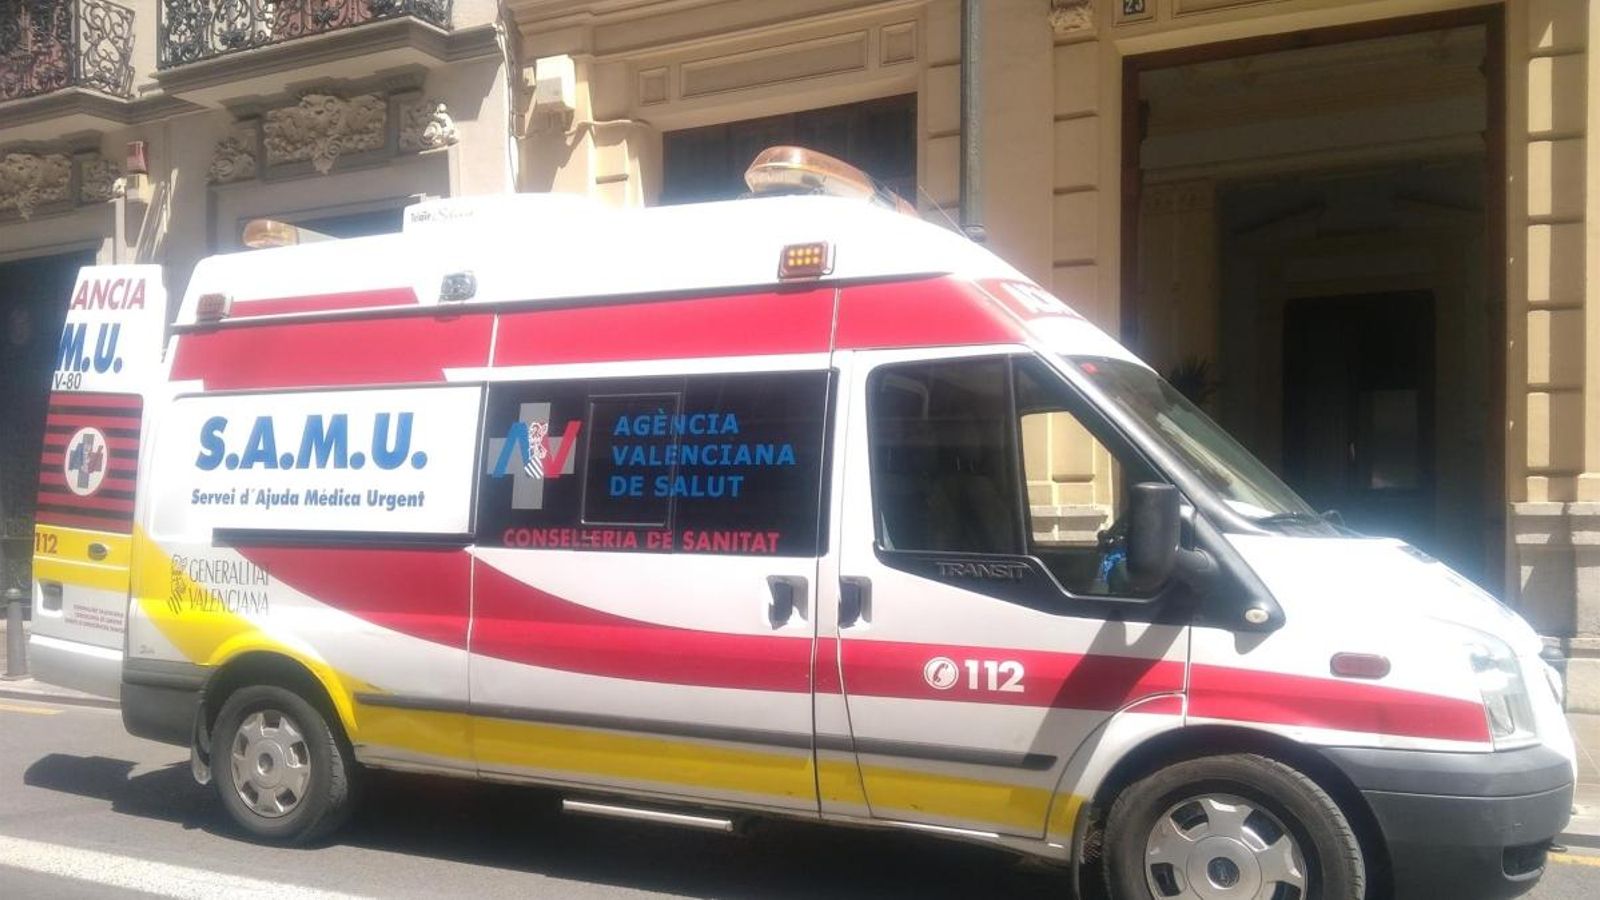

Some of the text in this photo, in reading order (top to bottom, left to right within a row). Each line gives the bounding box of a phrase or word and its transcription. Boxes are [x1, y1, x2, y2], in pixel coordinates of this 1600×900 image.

[71, 278, 146, 310] ANCIA
[56, 322, 123, 374] M.U.
[54, 373, 82, 390] V-80
[613, 409, 740, 436] AGÈNCIA
[195, 412, 428, 471] S.A.M.U.
[612, 443, 797, 466] VALENCIANA
[609, 474, 744, 498] DE SALUT
[191, 488, 236, 506] Servei
[304, 487, 361, 507] Médica
[366, 490, 425, 511] Urgent
[35, 532, 58, 554] 112
[503, 528, 780, 552] CONSELLERIA DE SANITAT
[189, 559, 271, 586] GENERALITAT
[937, 562, 1025, 579] TRANSIT
[188, 588, 270, 615] VALENCIANA
[965, 659, 1025, 693] 112
